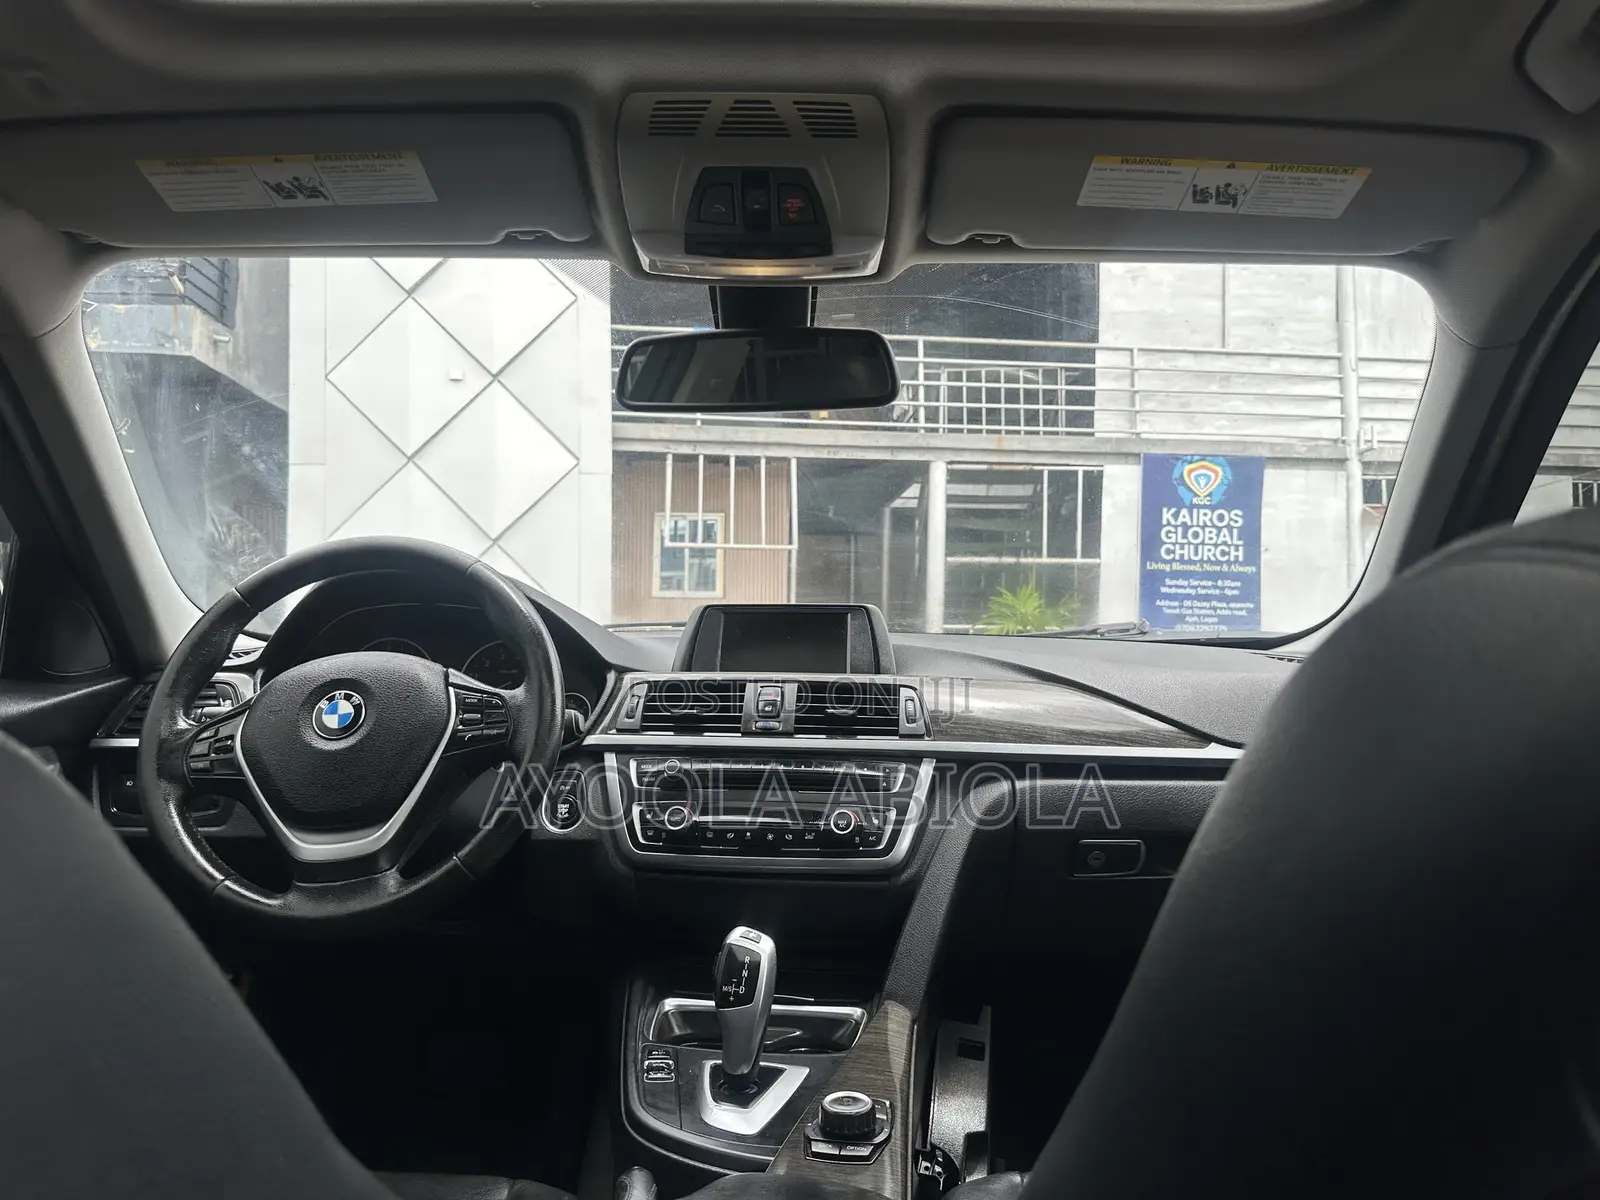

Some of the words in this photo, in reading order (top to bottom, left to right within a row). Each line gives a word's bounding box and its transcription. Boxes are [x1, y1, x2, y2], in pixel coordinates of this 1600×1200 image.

[1119, 156, 1172, 167] WARNING
[1265, 164, 1358, 176] AVERTISSEMENT
[1192, 497, 1212, 505] KGC
[1161, 507, 1244, 528] KAIROS
[1160, 526, 1244, 545] GLOBAL
[1160, 544, 1244, 562] CHURCH
[1146, 561, 1171, 573] Living
[1171, 562, 1202, 572] Blessed,
[1202, 563, 1222, 572] Now
[1222, 563, 1229, 572] &
[1229, 563, 1256, 574] Always
[1164, 578, 1188, 587] Sunday
[1189, 578, 1213, 587] Service
[1160, 586, 1196, 596] Wednesday
[1196, 587, 1220, 595] Service
[319, 692, 361, 709] BMW
[744, 955, 751, 964] R
[741, 969, 749, 978] N
[738, 985, 746, 994] D
